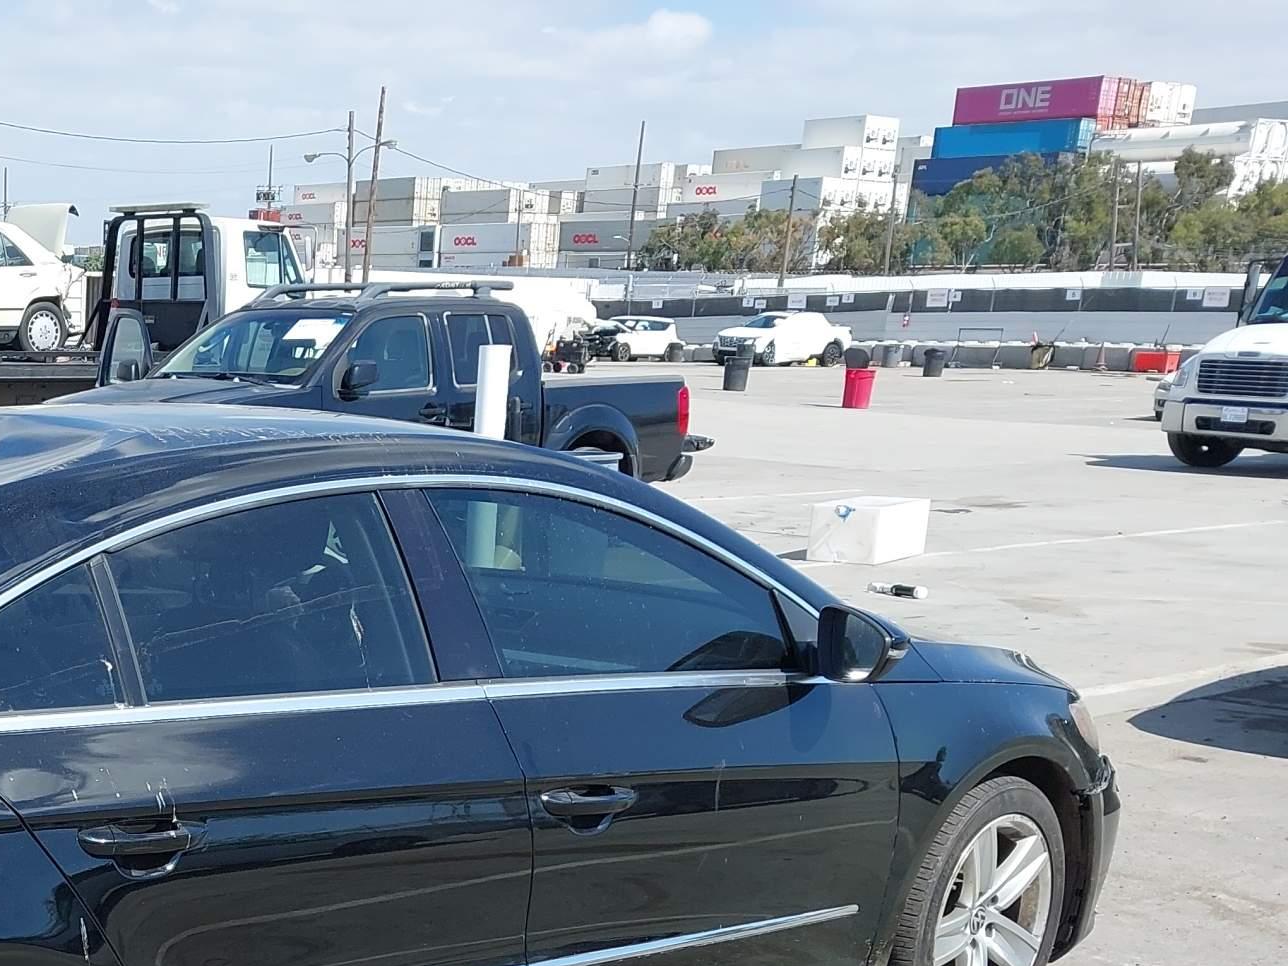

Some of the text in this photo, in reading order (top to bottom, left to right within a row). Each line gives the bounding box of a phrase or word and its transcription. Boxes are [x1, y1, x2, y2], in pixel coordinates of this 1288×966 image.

[999, 86, 1052, 110] ONE
[453, 236, 477, 247] OOCL
[572, 233, 599, 245] OOCL
